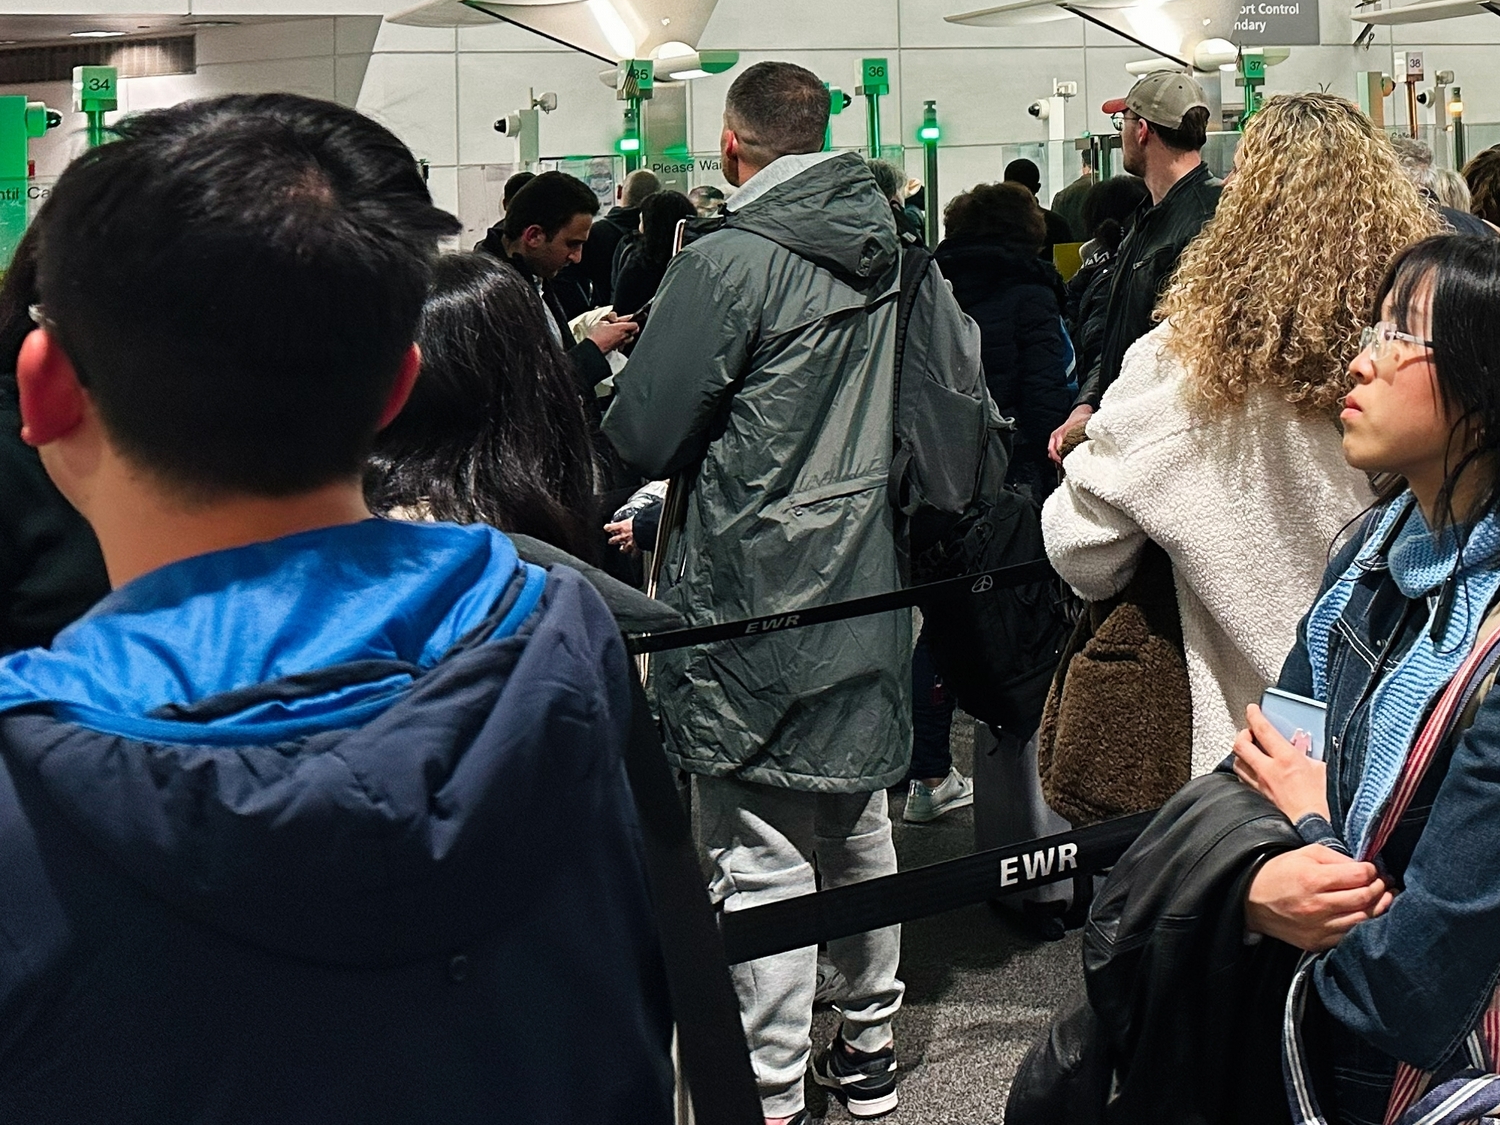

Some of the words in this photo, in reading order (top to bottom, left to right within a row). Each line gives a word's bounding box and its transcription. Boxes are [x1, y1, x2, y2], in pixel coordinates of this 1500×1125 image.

[1240, 4, 1256, 14] ort
[1258, 2, 1299, 15] Control
[1234, 18, 1267, 33] ndary
[1249, 61, 1261, 71] 37
[1409, 59, 1421, 68] 38
[868, 66, 885, 78] 36
[89, 78, 110, 91] 34
[653, 162, 694, 174] Please
[699, 159, 722, 171] Wai
[0, 187, 19, 201] ntil
[27, 186, 50, 200] Ca
[745, 615, 800, 634] EWR
[1000, 843, 1078, 887] EWR
